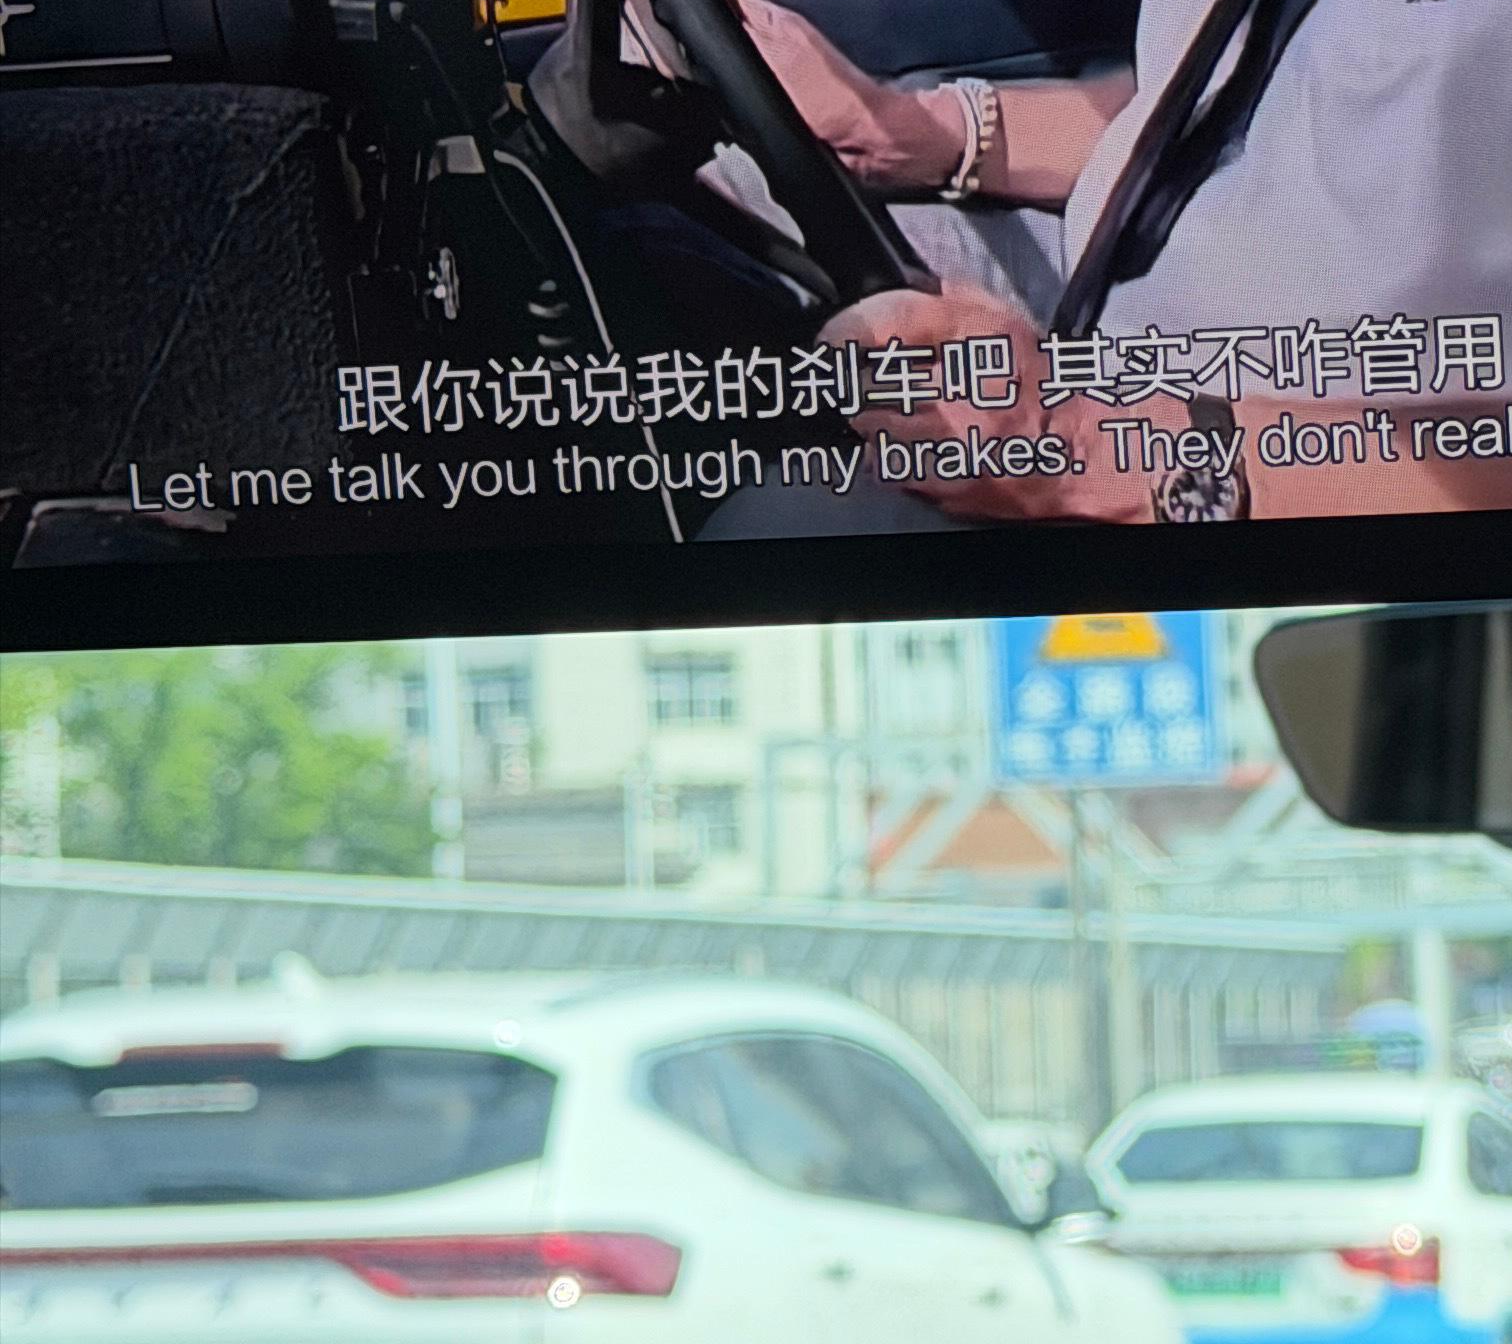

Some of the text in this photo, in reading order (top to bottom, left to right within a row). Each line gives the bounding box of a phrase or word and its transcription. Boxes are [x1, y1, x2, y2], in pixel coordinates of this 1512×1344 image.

[337, 314, 1504, 433] 跟你说说我的刹车吧 其实不咋管用
[130, 461, 213, 513] Let
[231, 470, 312, 507] me
[331, 454, 423, 503] talk
[441, 456, 537, 510] you
[552, 440, 763, 498] through
[781, 445, 861, 494] my
[880, 427, 1087, 481] brakes.
[1101, 419, 1243, 481] They
[1261, 412, 1397, 468] don't
